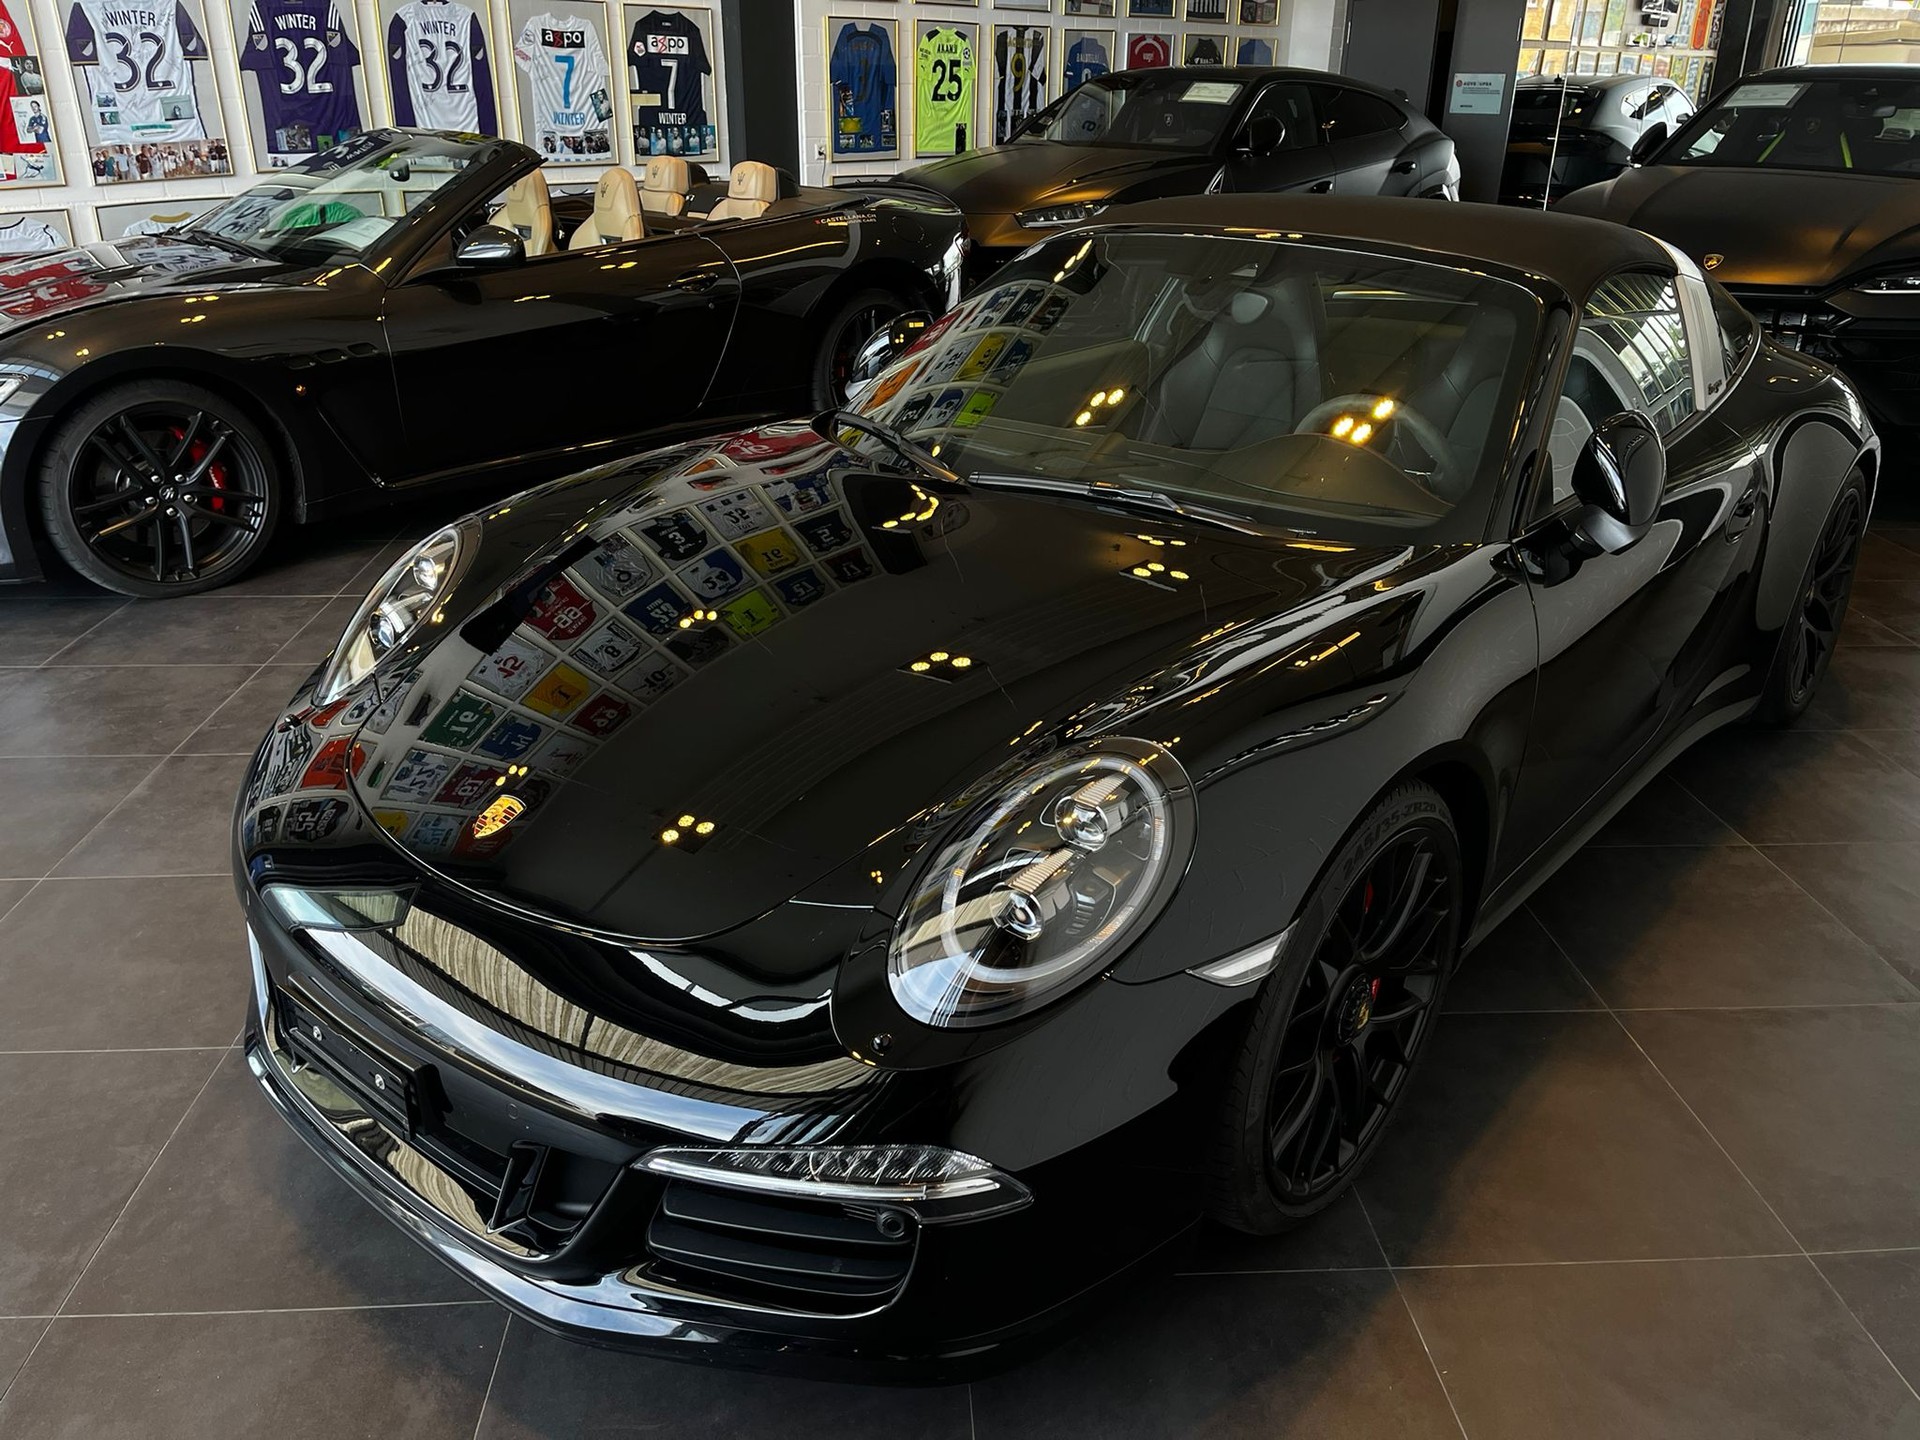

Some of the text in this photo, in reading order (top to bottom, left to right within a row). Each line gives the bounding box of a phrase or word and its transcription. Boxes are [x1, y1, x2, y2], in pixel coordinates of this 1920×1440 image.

[105, 10, 156, 27] WINTER
[274, 13, 317, 31] WINTER
[419, 21, 456, 37] WINTER
[105, 31, 176, 93] 32
[274, 37, 334, 94] 32
[418, 38, 470, 94] 32
[555, 54, 575, 109] 7
[931, 59, 963, 102] 25
[1011, 52, 1026, 92] 9
[660, 59, 679, 110] 7
[553, 111, 586, 126] WINTER
[658, 112, 687, 125] WINTER
